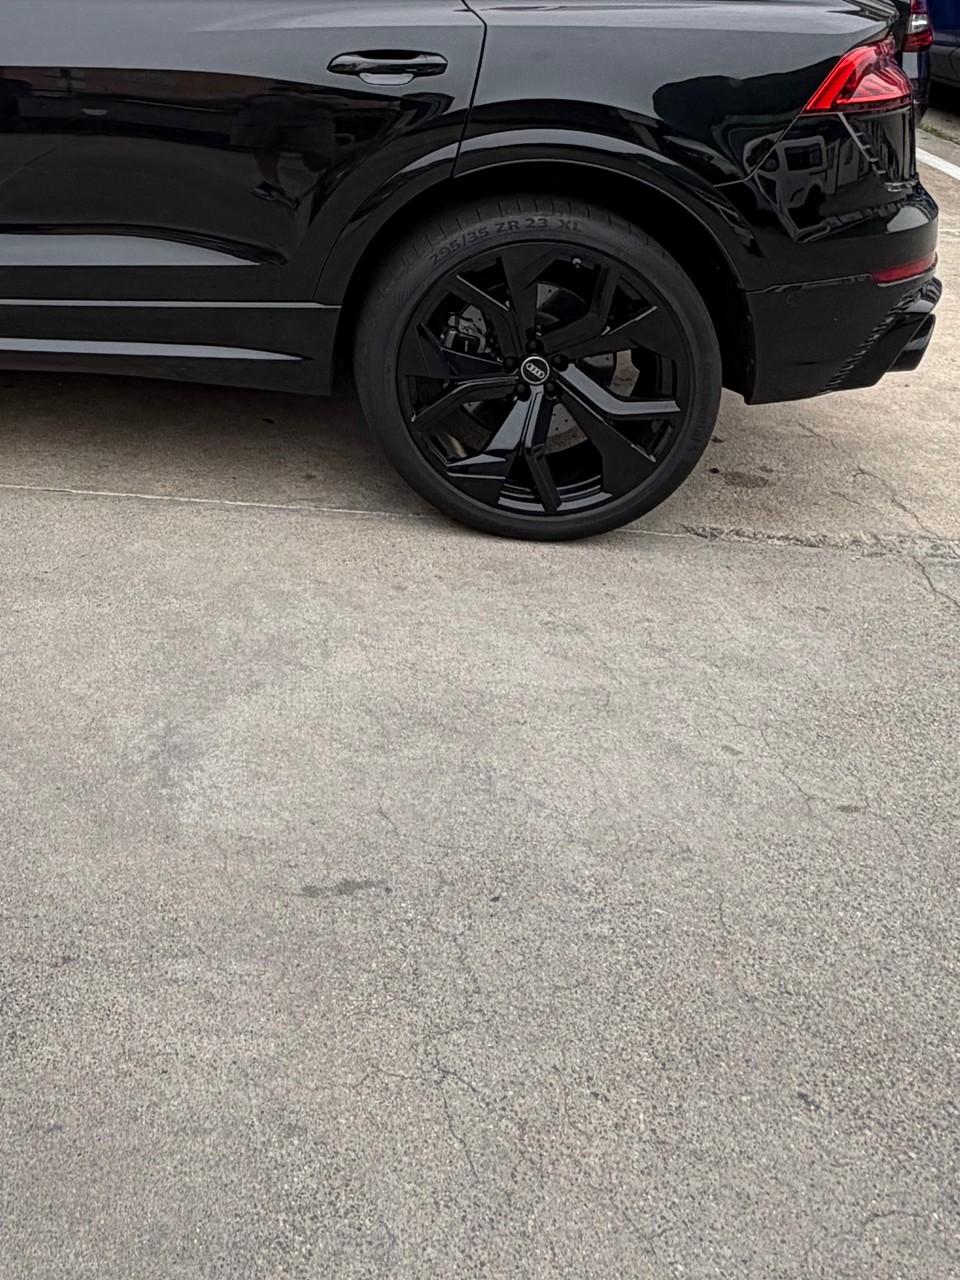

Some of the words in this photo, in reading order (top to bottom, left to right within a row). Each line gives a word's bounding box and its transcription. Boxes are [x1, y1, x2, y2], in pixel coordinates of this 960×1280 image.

[429, 226, 490, 266] 295/35
[494, 220, 521, 233] ZR
[525, 218, 548, 229] 23
[558, 219, 583, 233] XL
